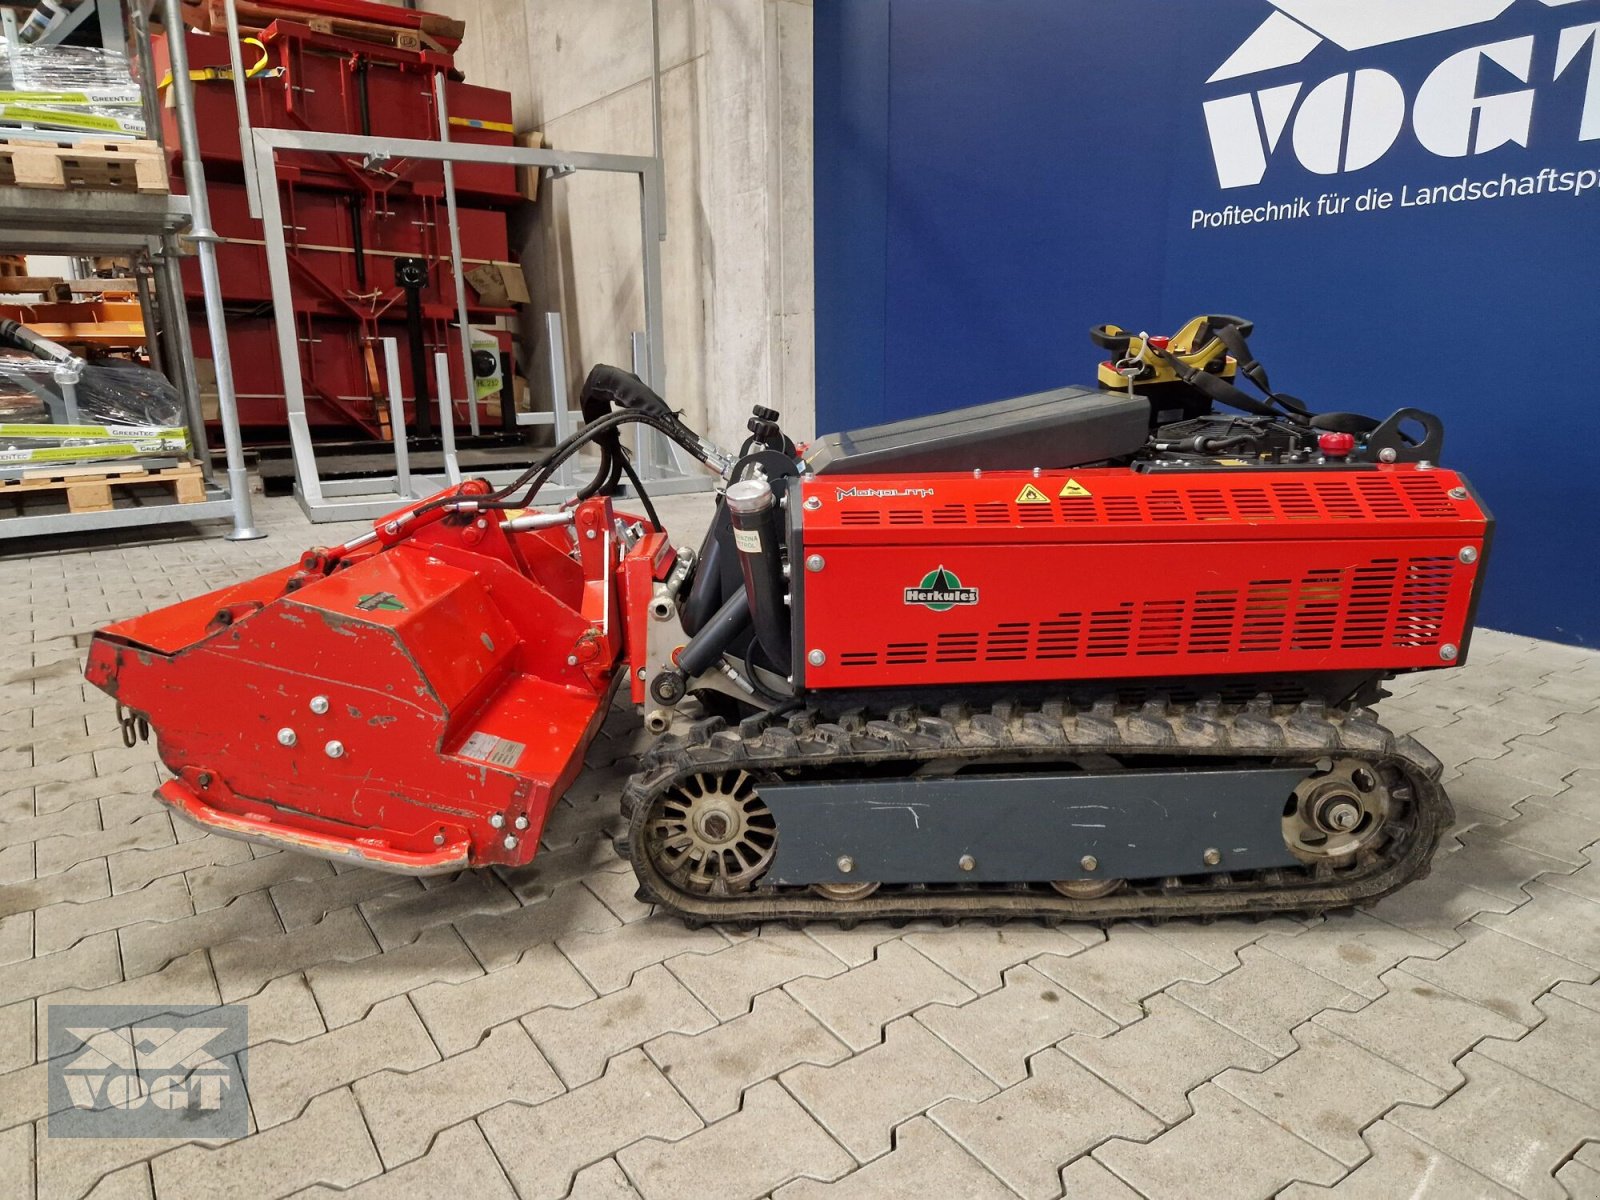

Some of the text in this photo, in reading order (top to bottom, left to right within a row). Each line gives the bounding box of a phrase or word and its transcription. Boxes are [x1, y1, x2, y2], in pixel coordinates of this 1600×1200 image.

[1190, 167, 1600, 230] Profitechnik für die Landschaftsp
[906, 590, 976, 601] Herkules
